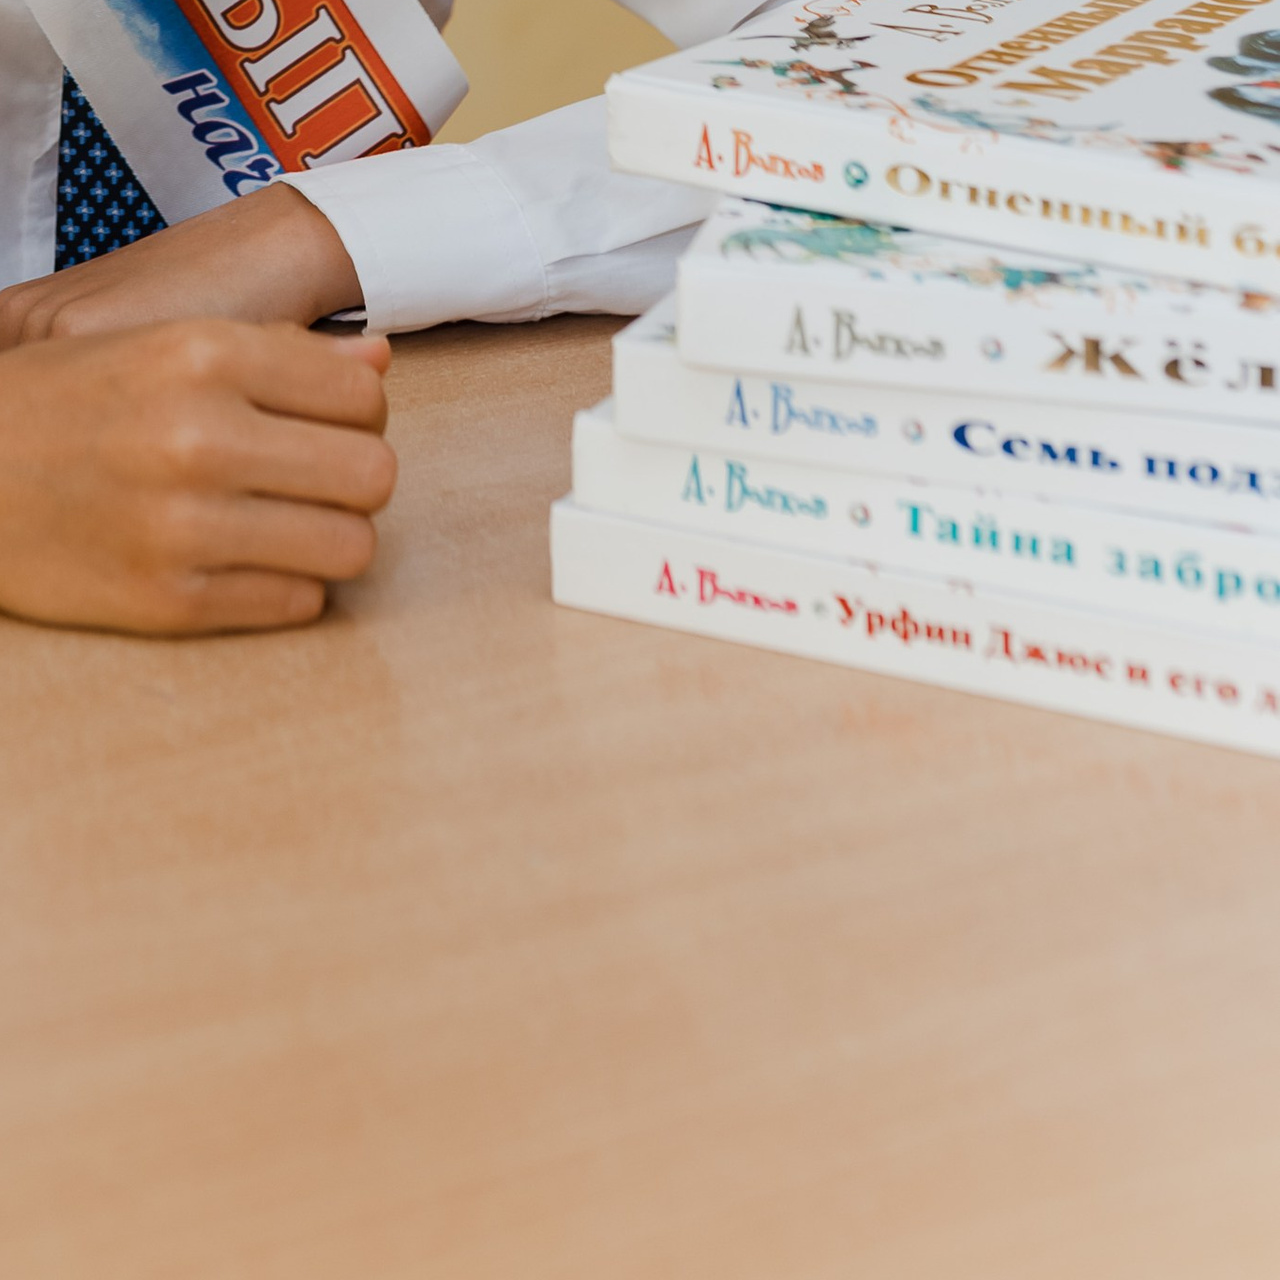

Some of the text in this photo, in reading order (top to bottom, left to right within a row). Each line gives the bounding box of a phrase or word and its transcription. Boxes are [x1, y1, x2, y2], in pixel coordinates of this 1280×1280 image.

[694, 122, 1280, 260] А. Волков Огненный б
[784, 305, 821, 357] А.
[725, 378, 760, 429] А.
[952, 421, 1123, 471] Семь
[682, 455, 715, 506] А.
[899, 500, 1078, 568] Тайна
[655, 560, 688, 597] А.
[834, 593, 974, 648] Урфин
